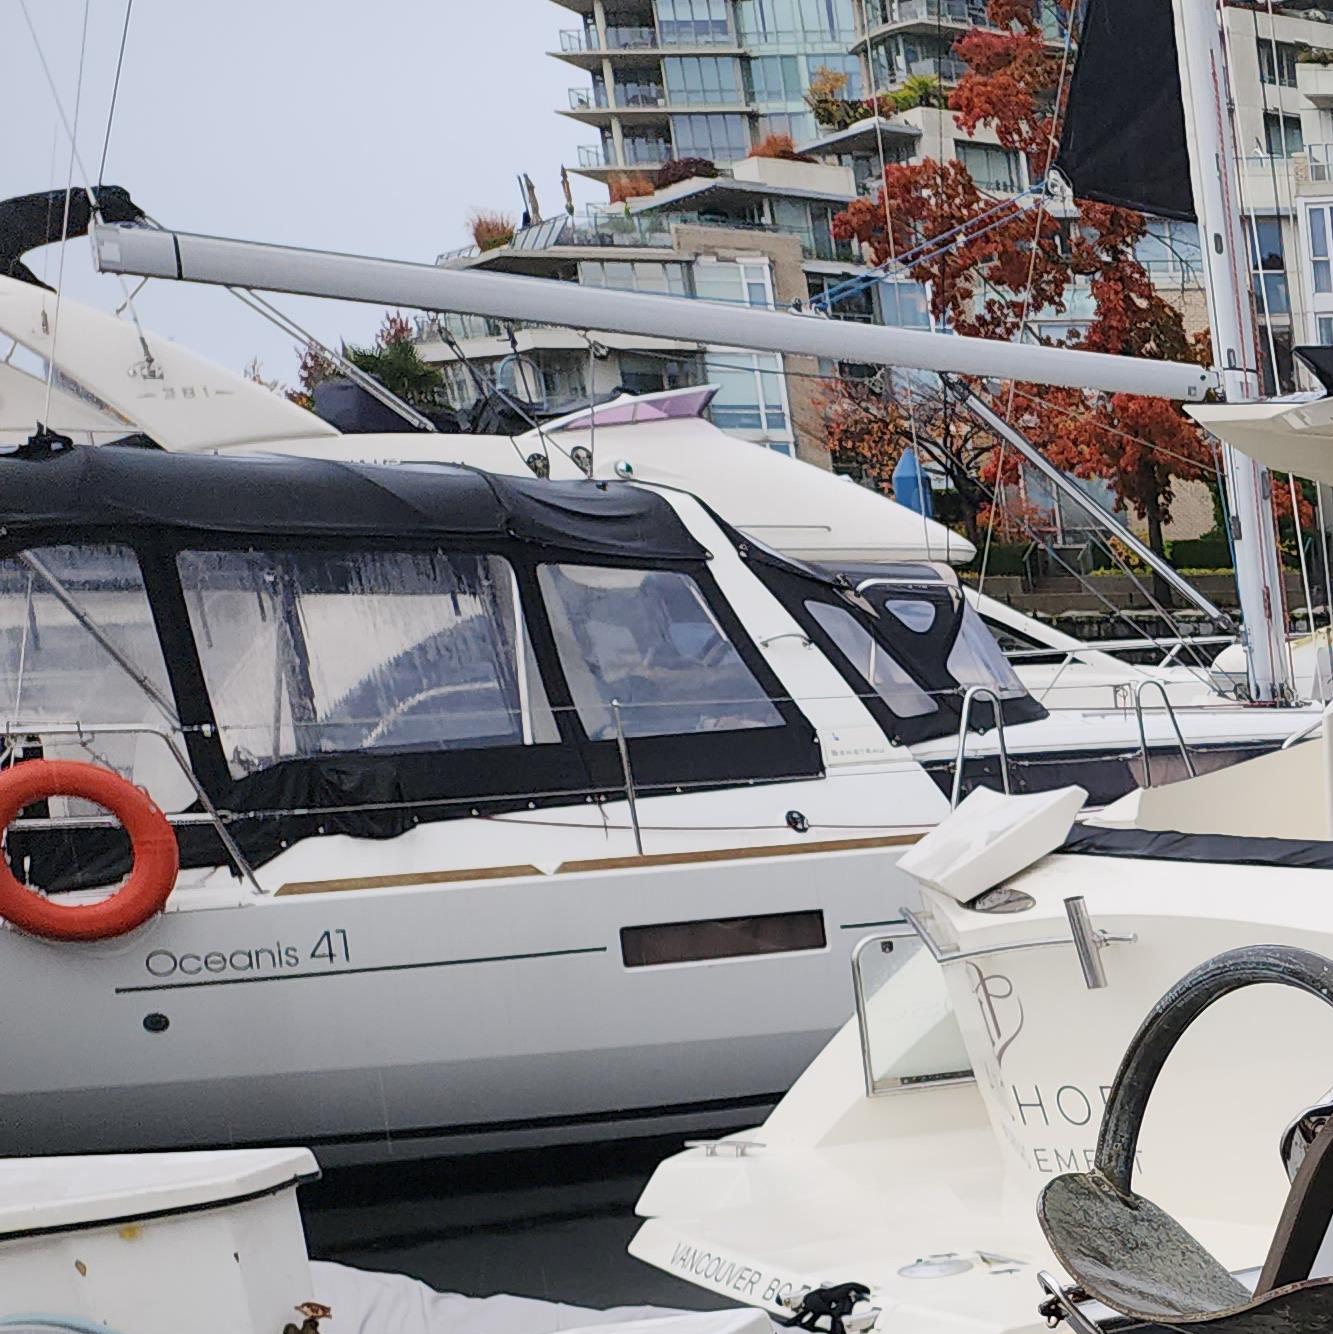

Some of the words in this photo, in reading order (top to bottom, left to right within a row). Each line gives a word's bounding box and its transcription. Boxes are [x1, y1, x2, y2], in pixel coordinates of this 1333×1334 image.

[146, 941, 299, 977] Oceanis
[309, 928, 350, 964] 41
[670, 1241, 763, 1297] VANCOUVER
